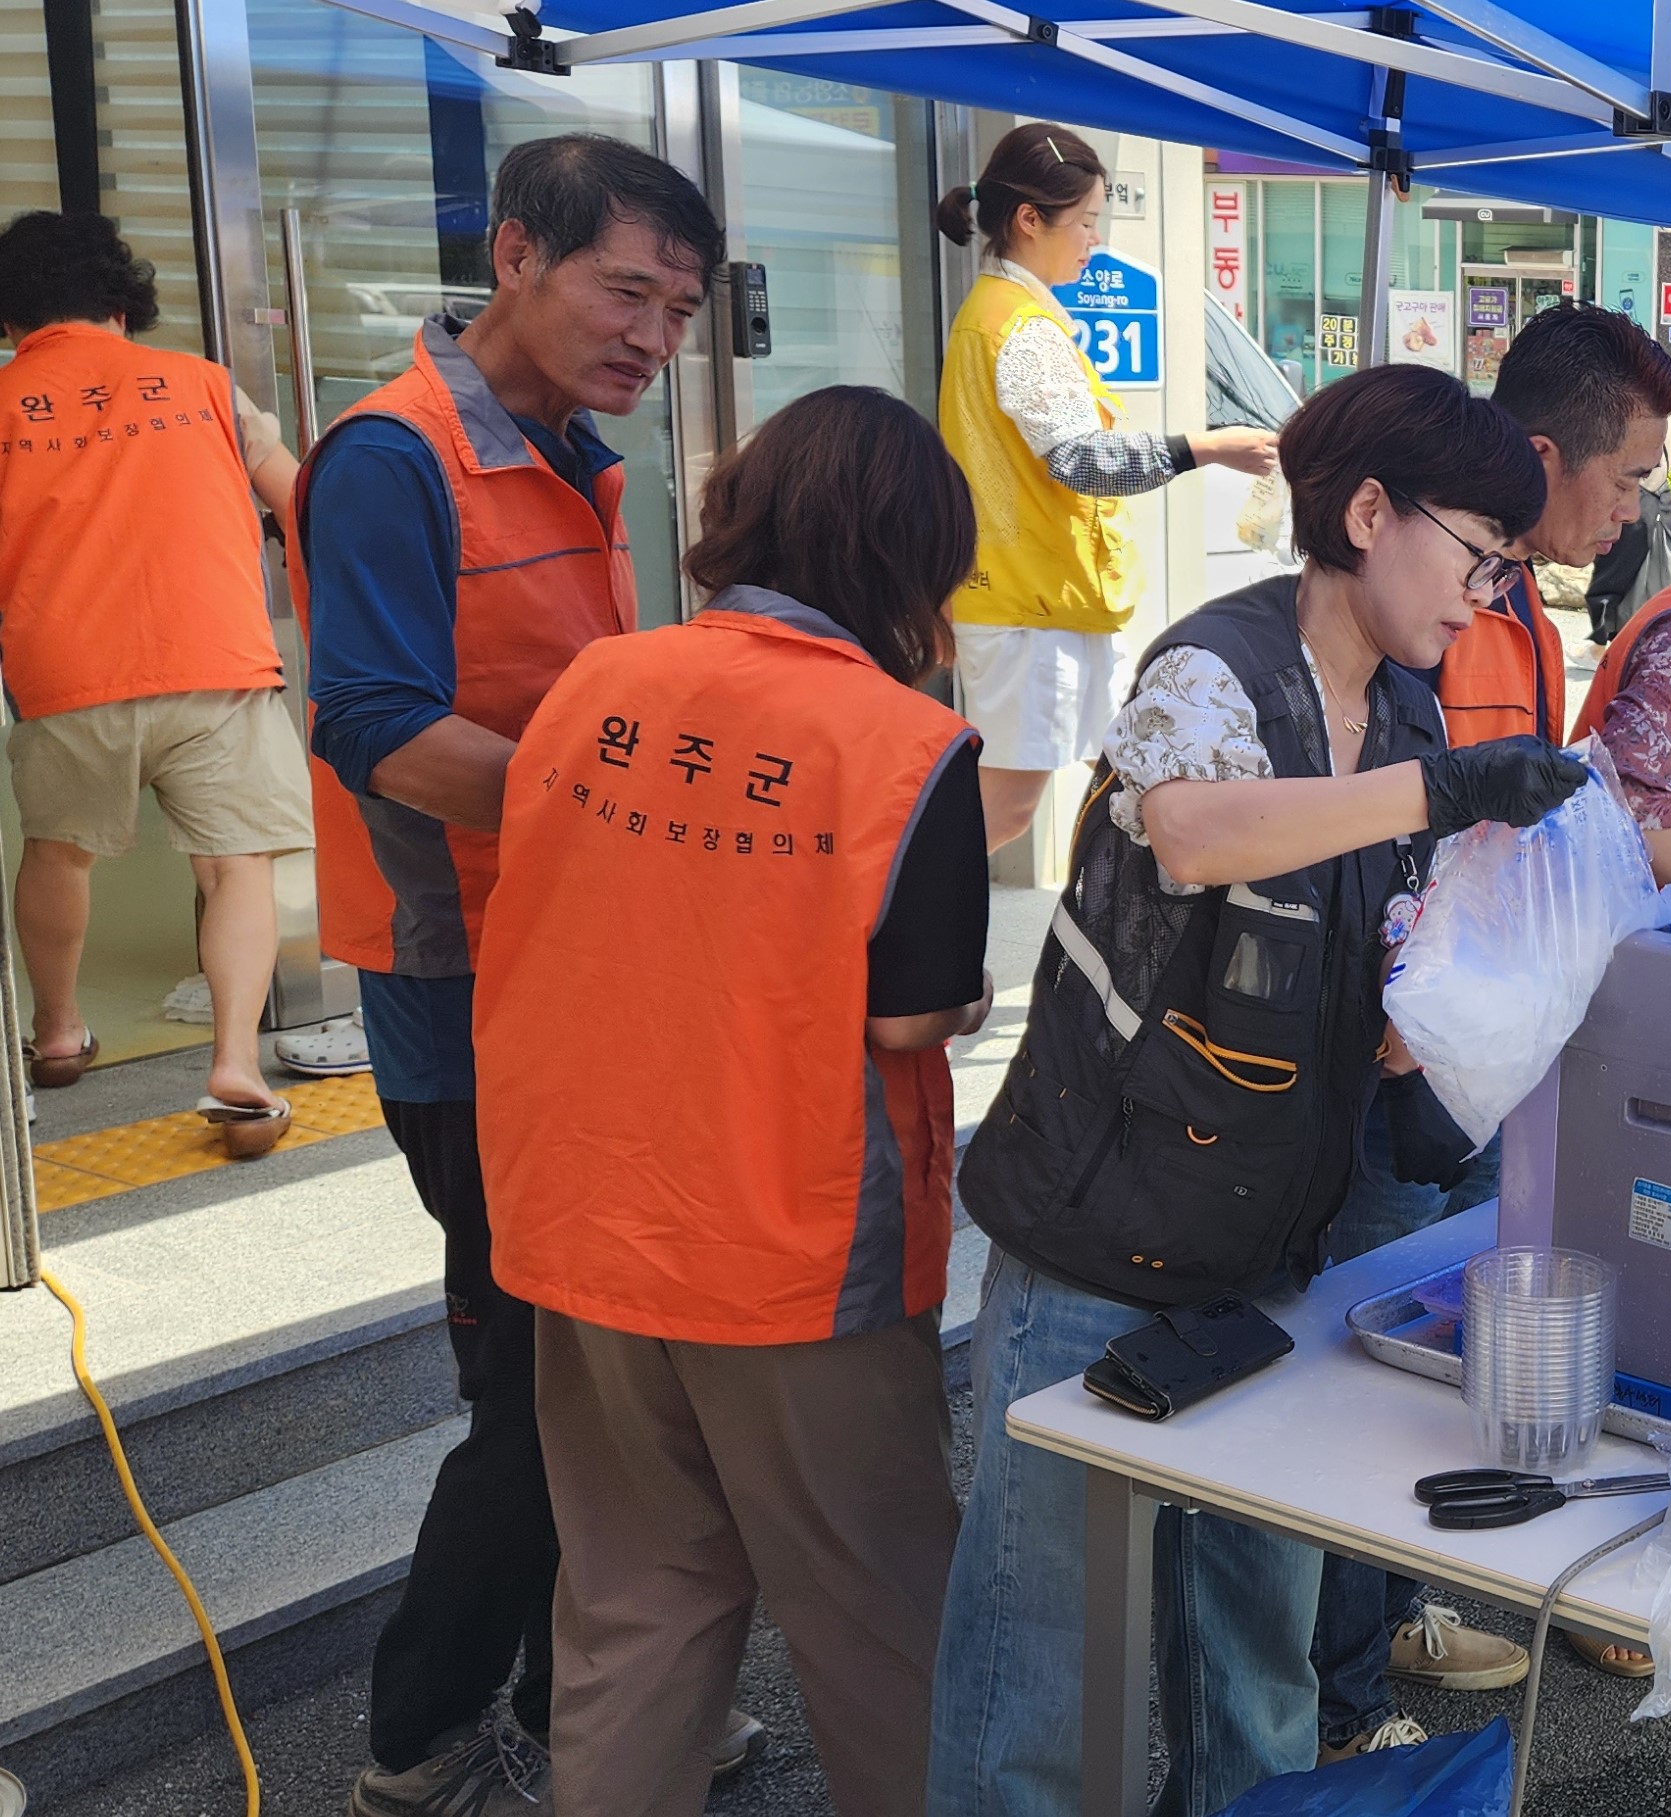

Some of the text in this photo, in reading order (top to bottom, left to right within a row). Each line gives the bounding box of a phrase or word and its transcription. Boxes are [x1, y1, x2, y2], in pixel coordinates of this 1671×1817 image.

[1213, 191, 1243, 320] 부동
[1080, 268, 1126, 293] 소양로
[1077, 291, 1129, 307] Soyang-ro
[1396, 301, 1446, 313] 군고구마 판매
